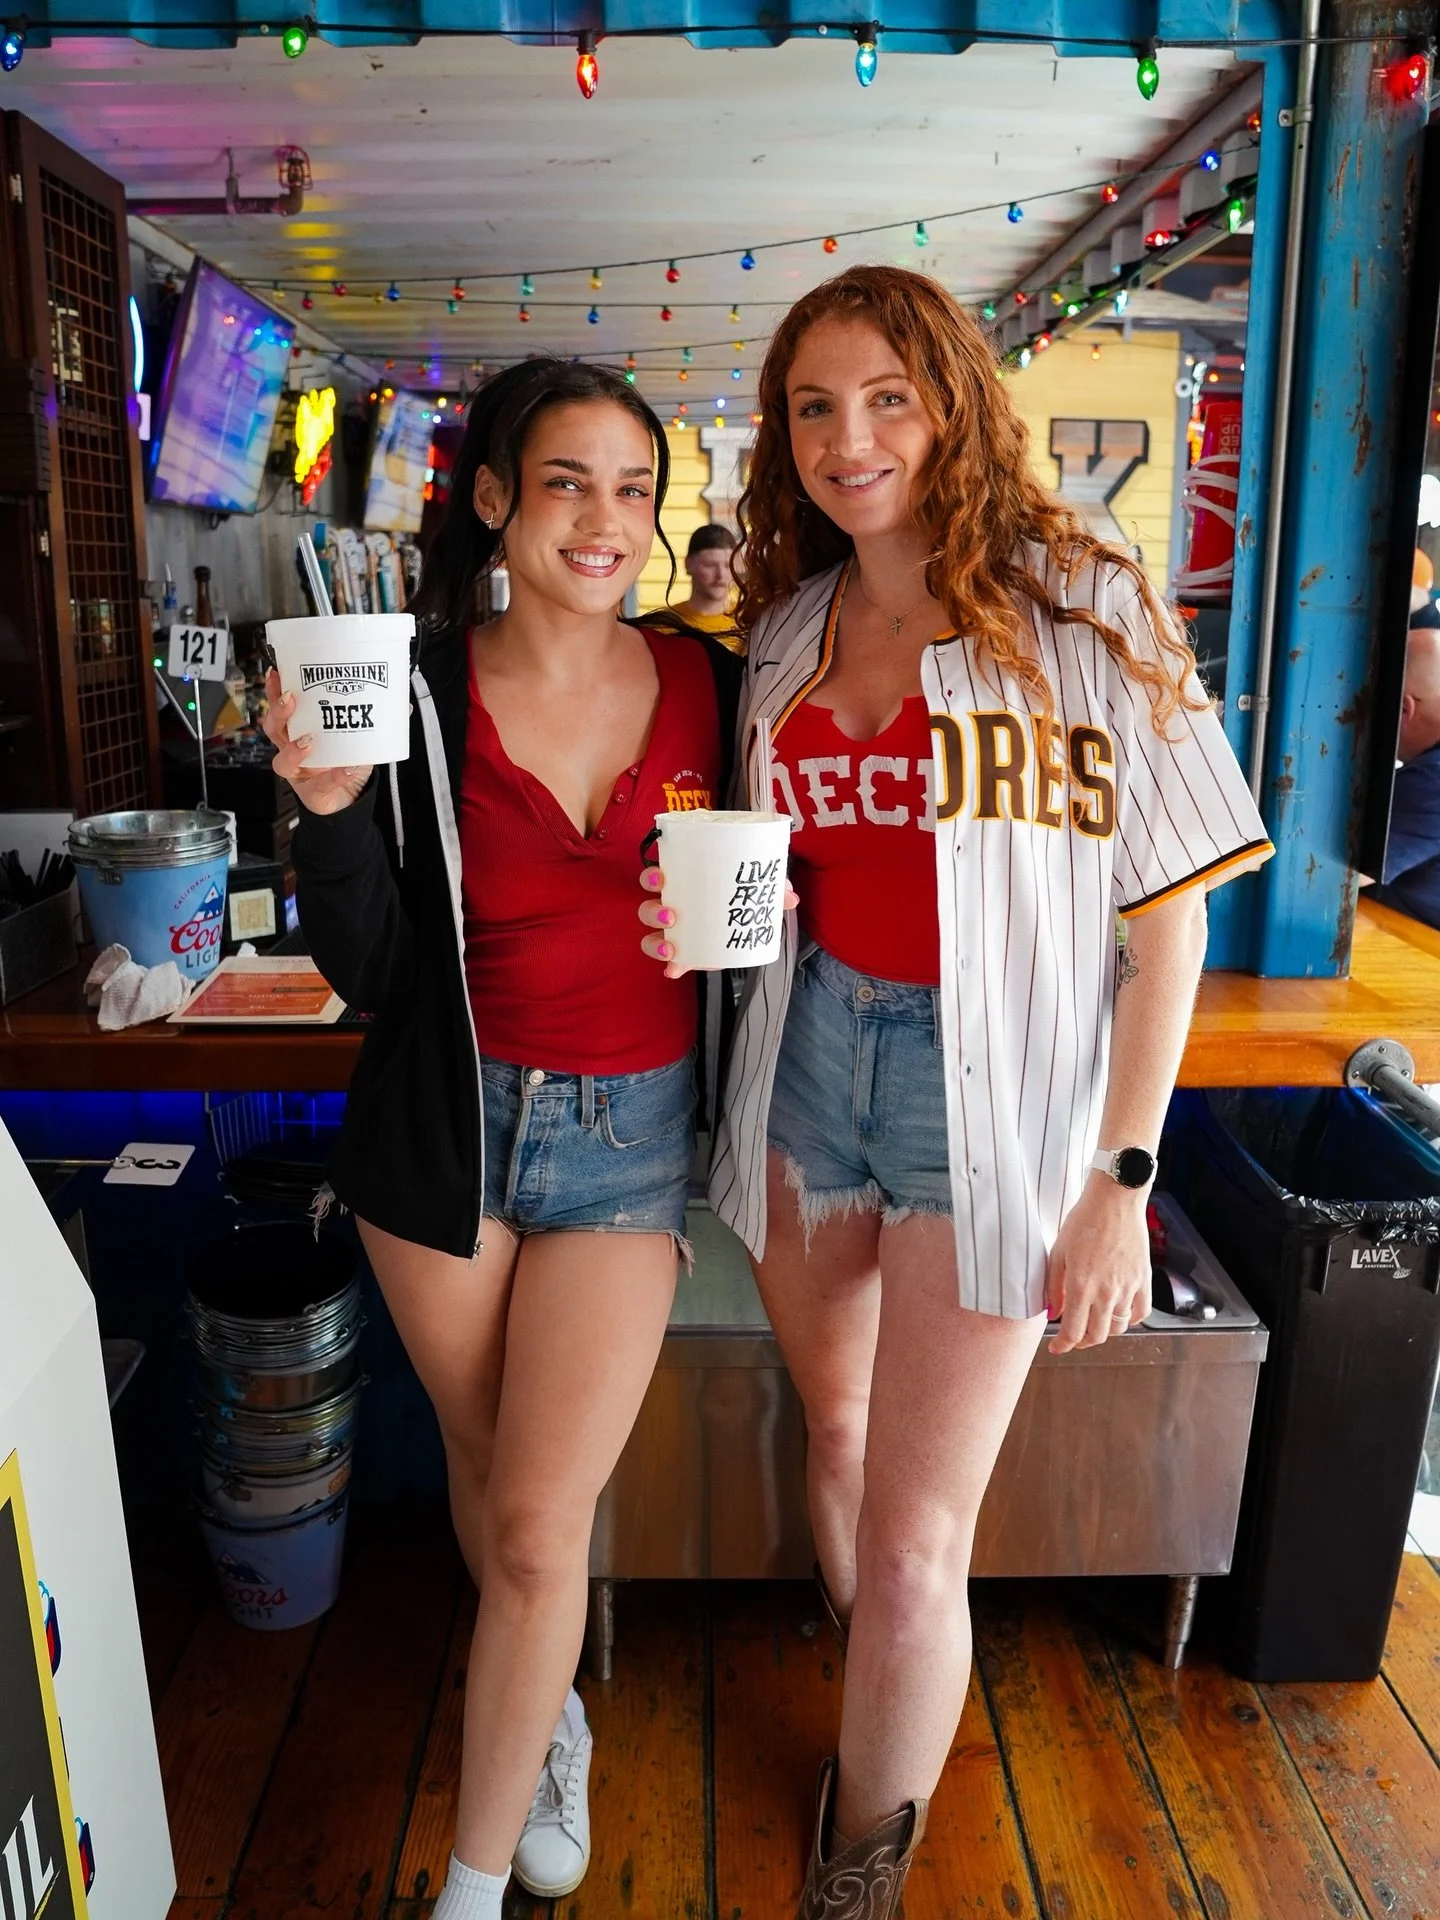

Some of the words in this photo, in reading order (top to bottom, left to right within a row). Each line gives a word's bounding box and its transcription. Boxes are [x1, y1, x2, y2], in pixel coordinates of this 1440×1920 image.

[180, 630, 217, 665] 121
[303, 665, 386, 686] MOONSHINE
[328, 683, 363, 693] FLATS
[321, 704, 374, 729] DECK
[735, 859, 781, 884] LIVE
[174, 874, 211, 911] CALIFORNIA
[729, 883, 776, 906] FREE
[728, 906, 774, 926] ROCK
[726, 925, 774, 950] HARD
[1350, 1245, 1401, 1269] LAVEX
